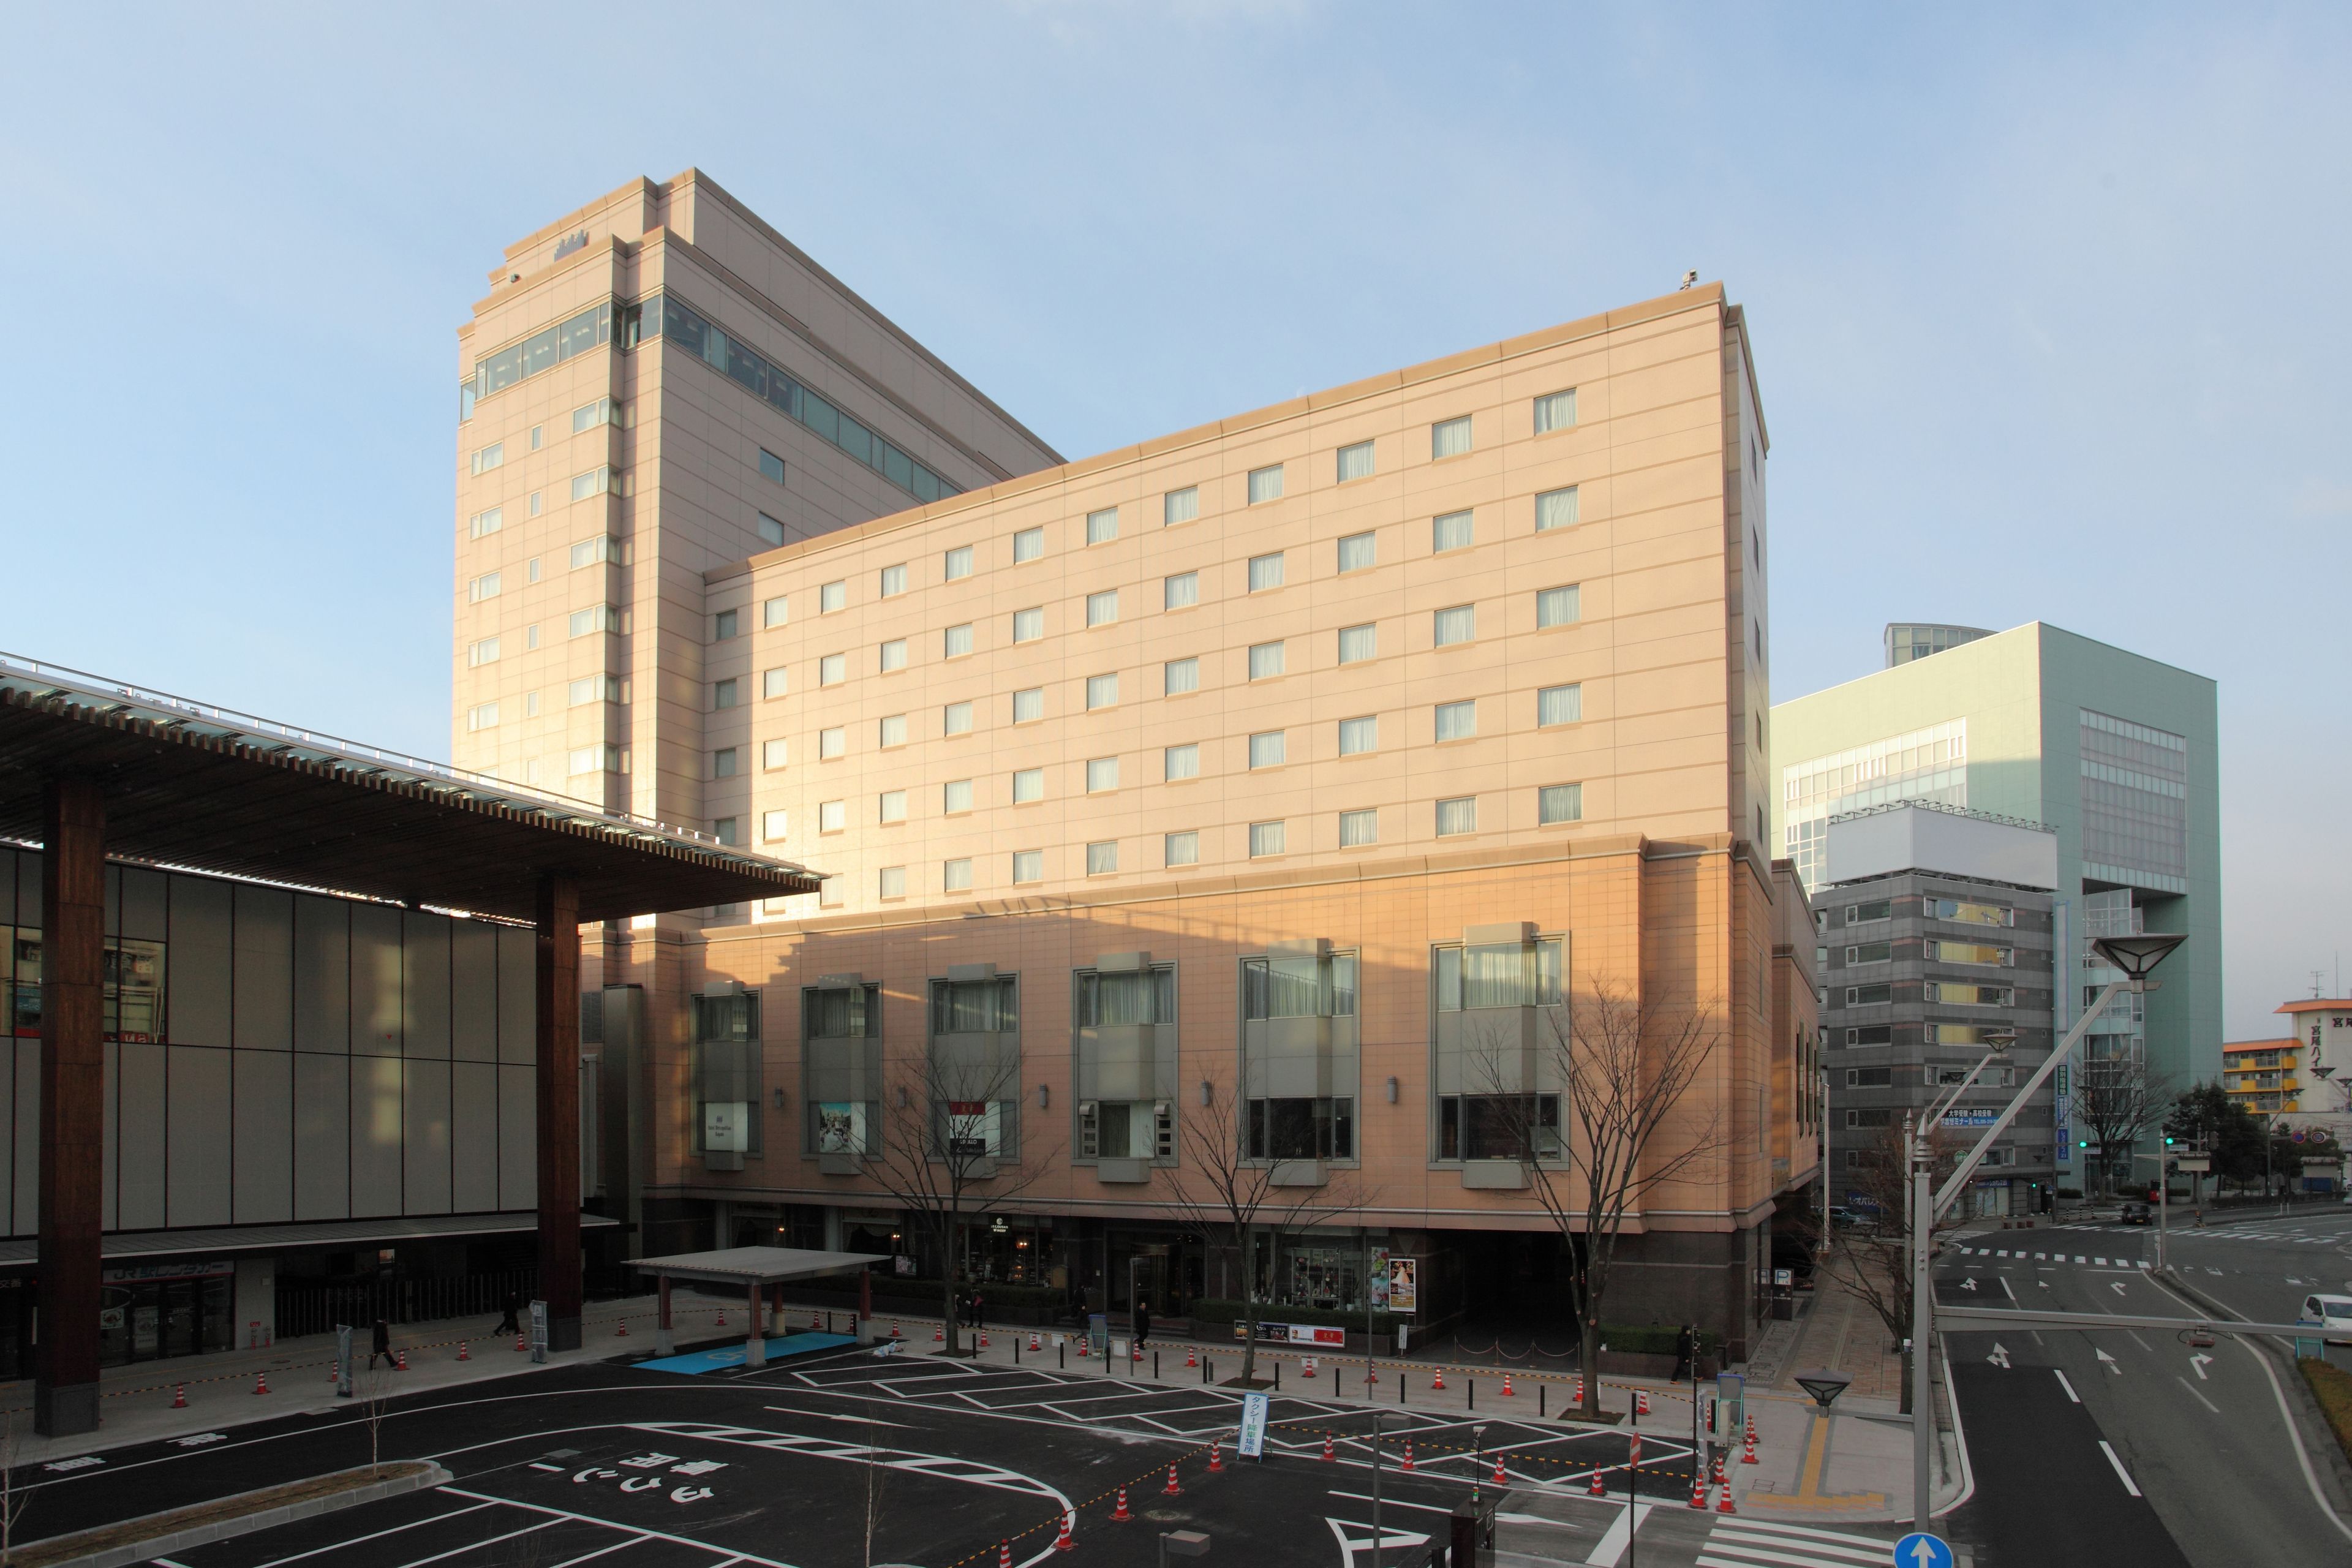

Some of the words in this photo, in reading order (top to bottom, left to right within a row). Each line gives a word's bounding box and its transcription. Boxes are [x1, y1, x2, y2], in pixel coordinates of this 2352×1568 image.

[2311, 1025, 2321, 1077] 宮尾ハイ
[1777, 1271, 1789, 1283] P
[1244, 1396, 1260, 1452] タクシー降車場所
